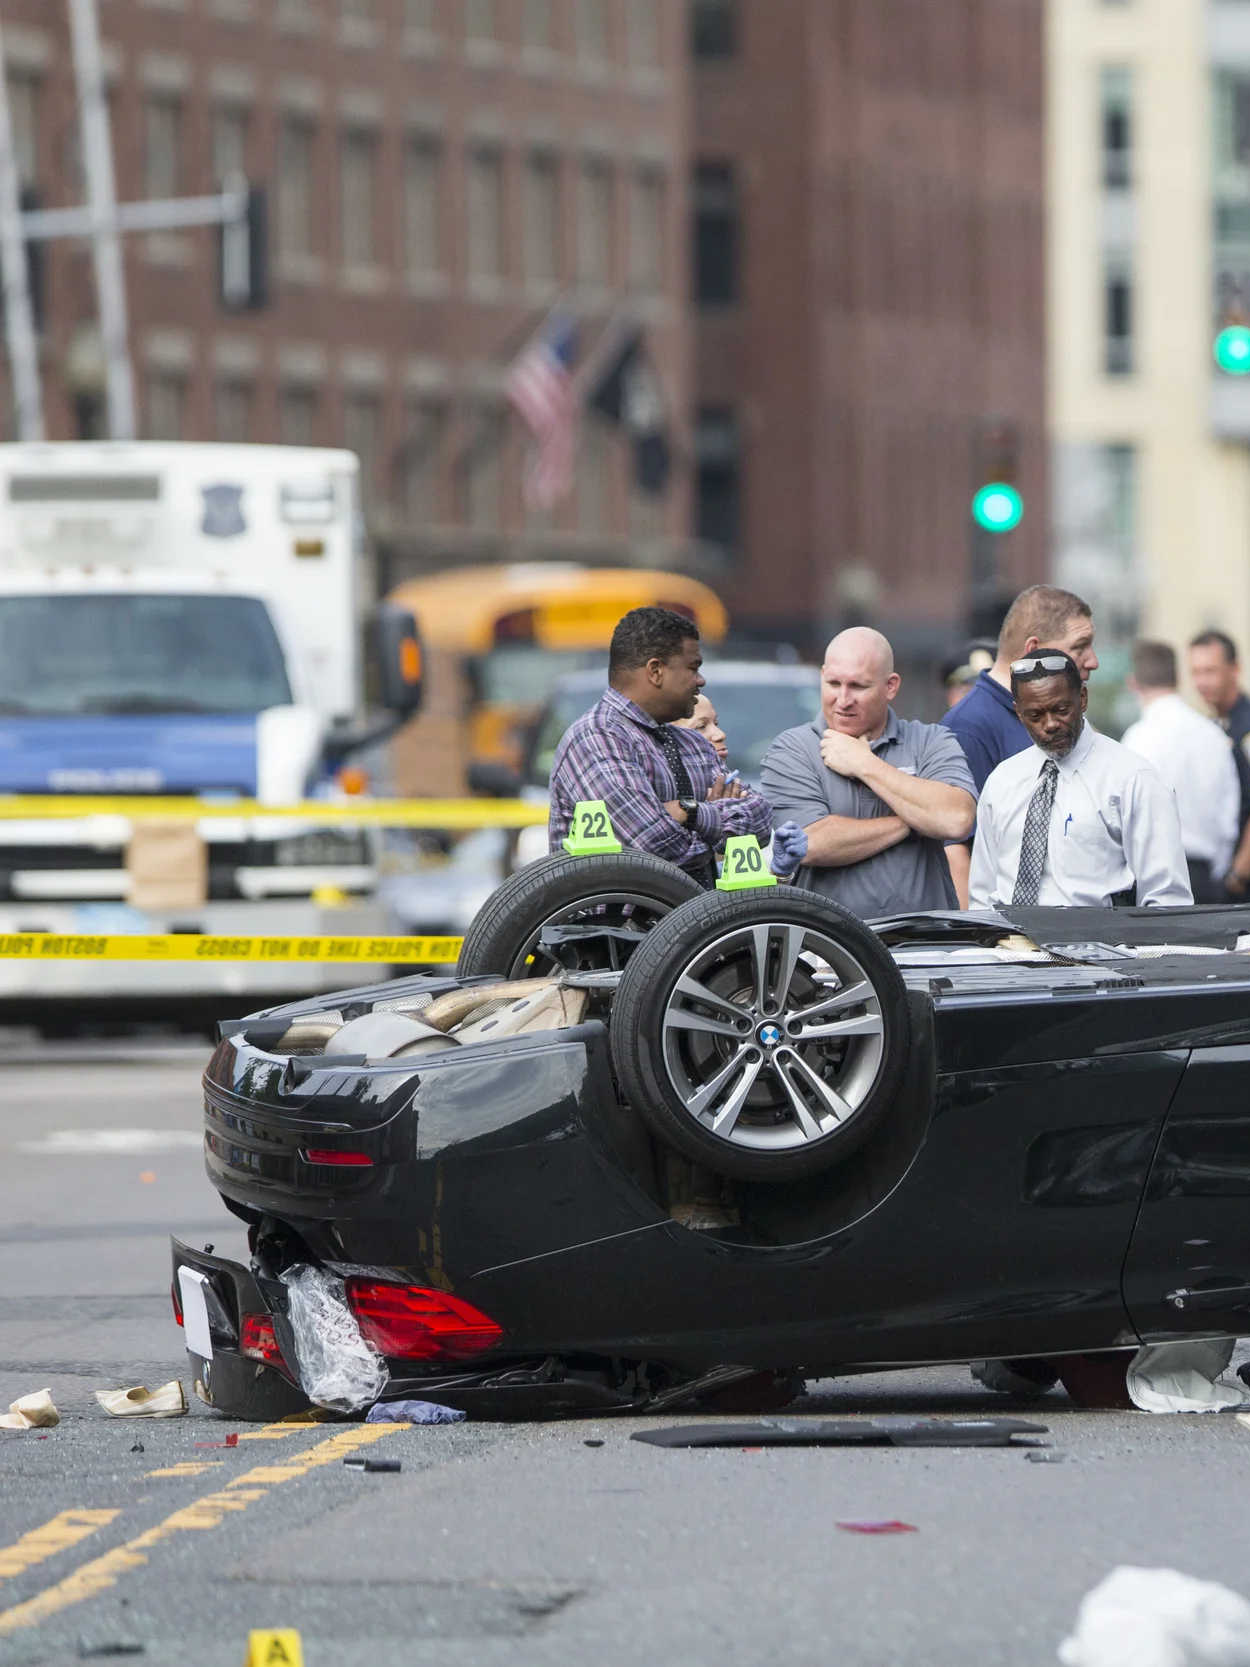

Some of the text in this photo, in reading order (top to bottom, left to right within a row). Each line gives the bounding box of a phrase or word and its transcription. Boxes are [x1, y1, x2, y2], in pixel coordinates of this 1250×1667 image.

[581, 811, 608, 838] 22
[732, 846, 762, 873] 20
[264, 1638, 291, 1665] A
